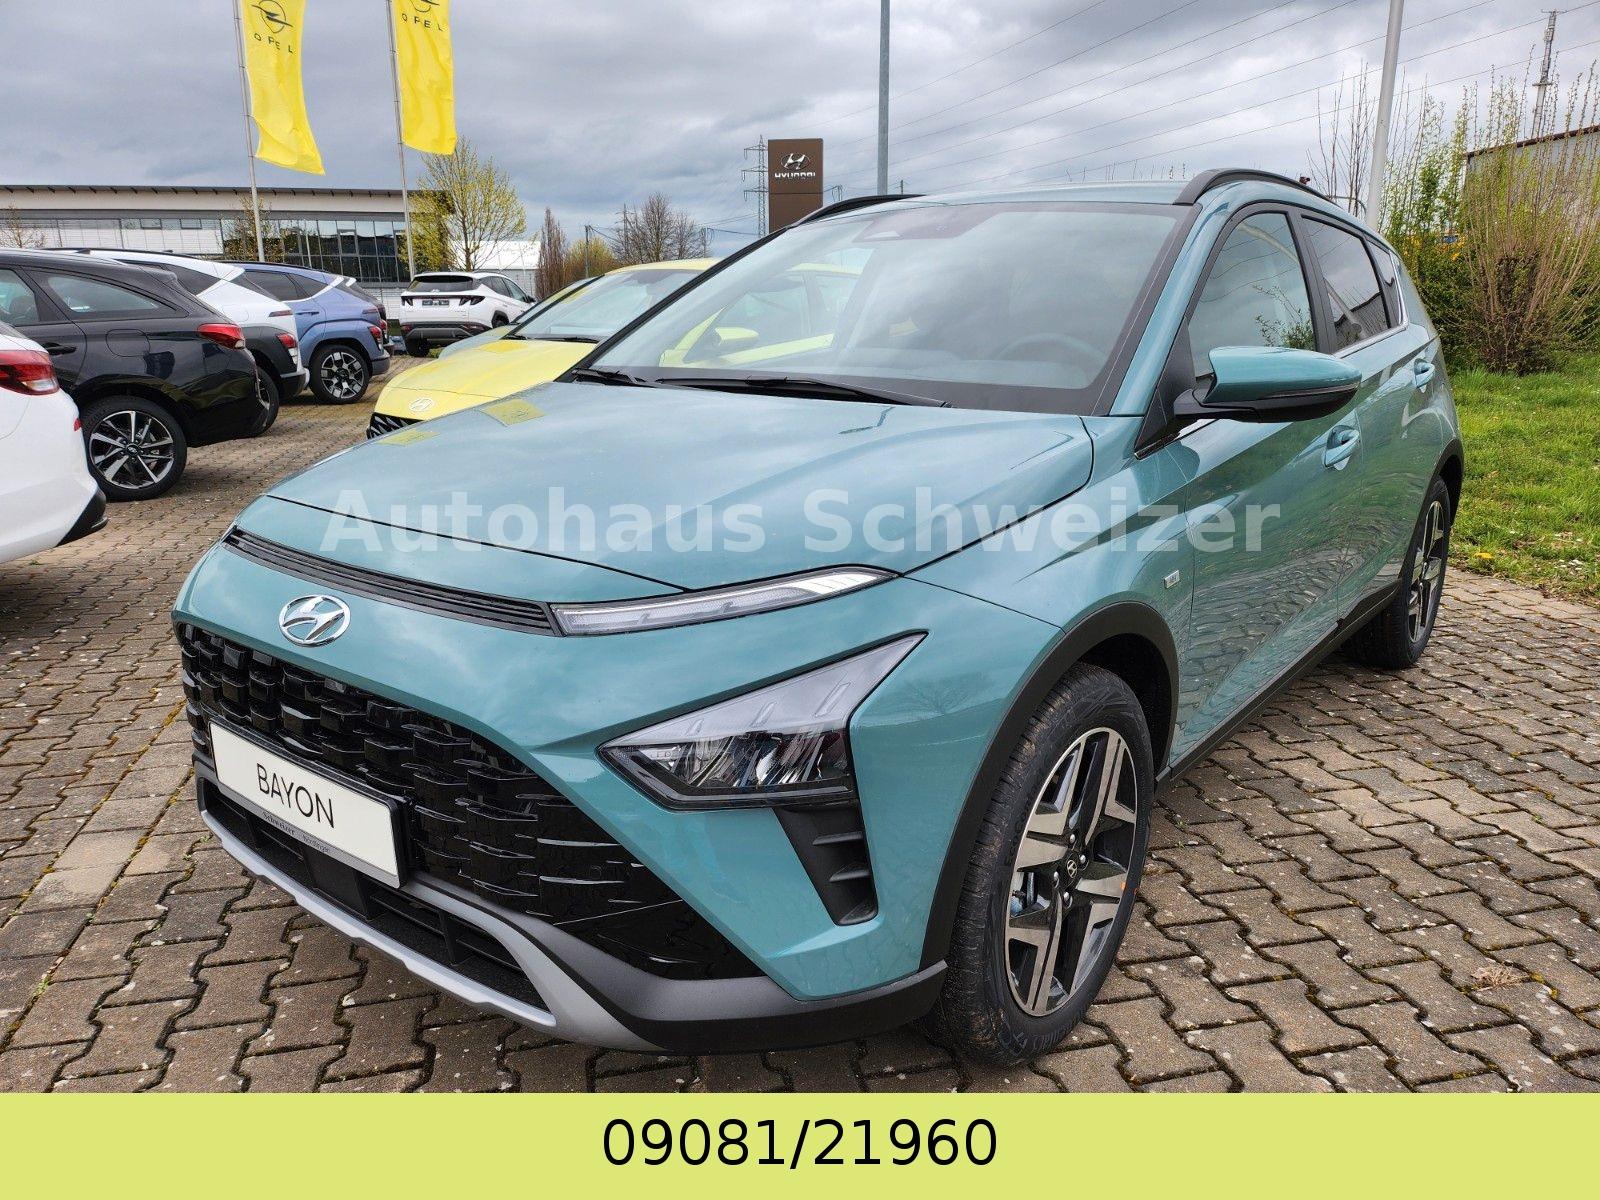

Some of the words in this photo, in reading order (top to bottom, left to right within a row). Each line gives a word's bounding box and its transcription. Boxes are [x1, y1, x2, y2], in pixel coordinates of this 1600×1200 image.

[401, 13, 443, 32] OPEL
[254, 32, 294, 54] OPEL
[256, 762, 335, 829] BAYON
